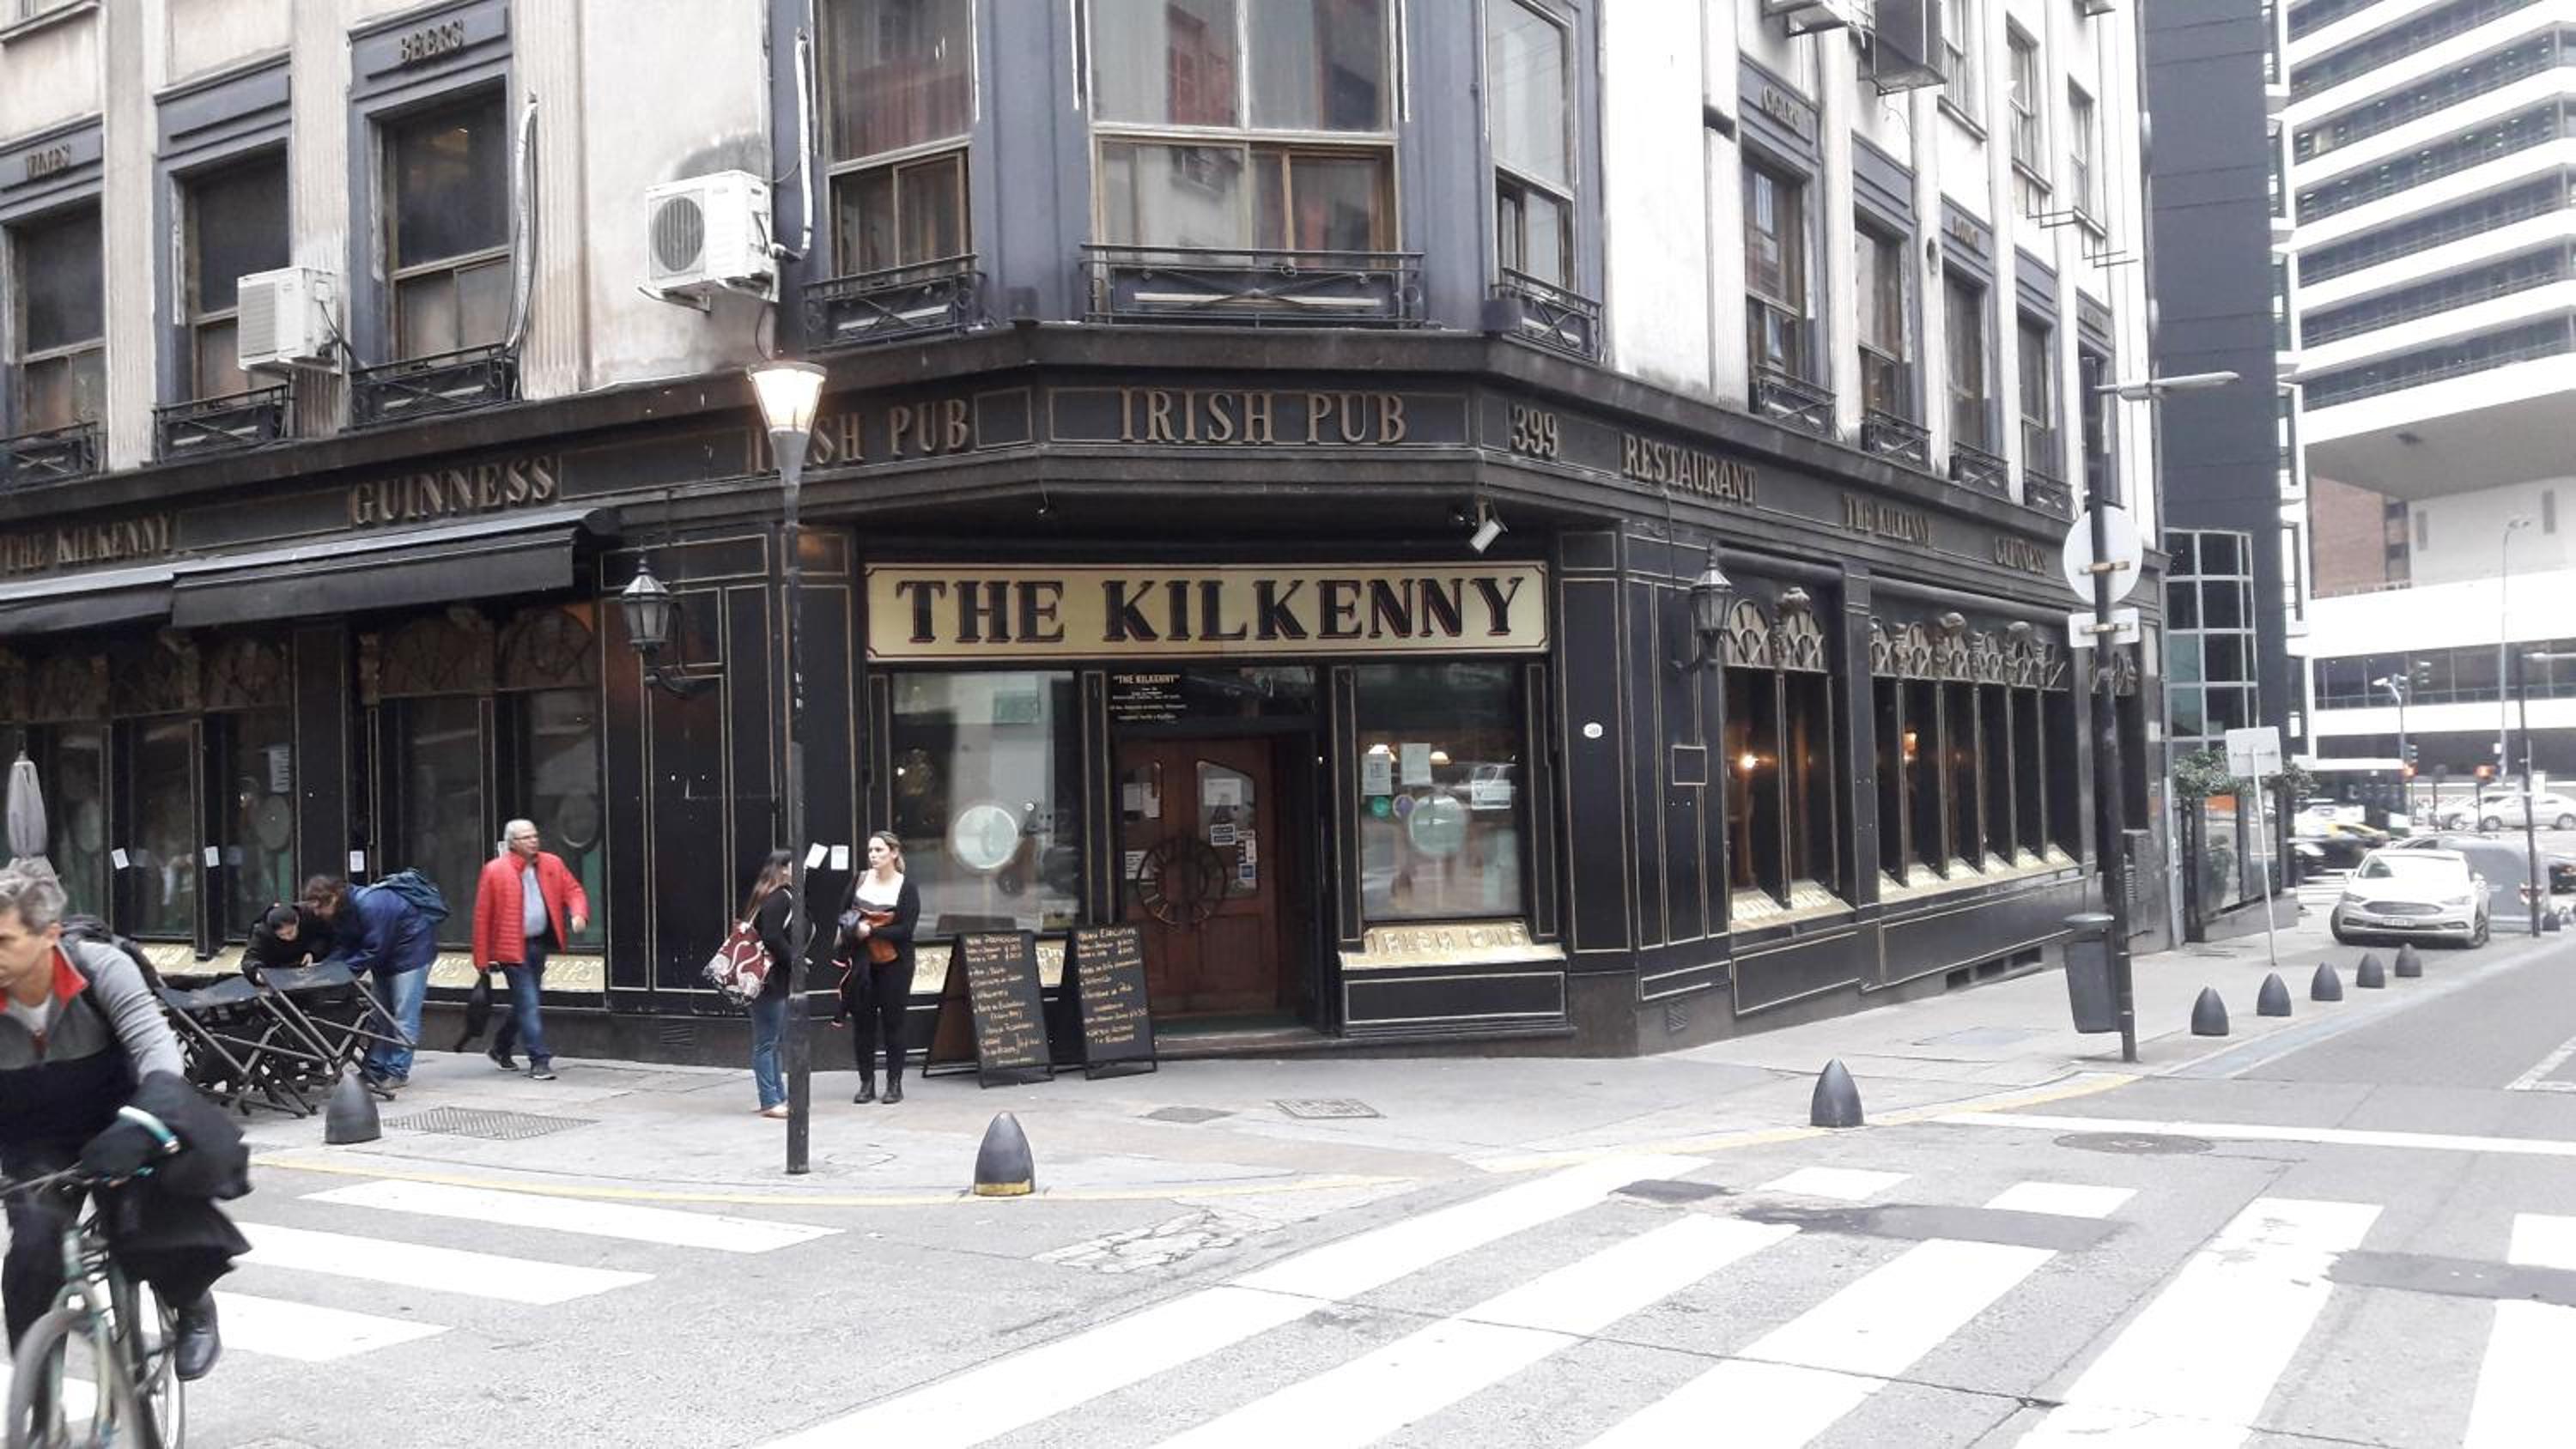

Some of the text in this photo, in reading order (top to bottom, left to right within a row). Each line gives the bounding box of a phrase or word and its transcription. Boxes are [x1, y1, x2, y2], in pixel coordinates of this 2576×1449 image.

[399, 19, 465, 63] BEERS
[745, 398, 969, 474] ISH PUB
[1120, 387, 1407, 443] IRISH PUB
[1510, 403, 1560, 458] 399
[349, 455, 556, 525] GUINNESS
[1622, 433, 1759, 504] RESTAURANT
[1843, 494, 1874, 530] THE
[2, 513, 172, 572] THE KILKENNY
[896, 577, 1524, 644] THE KILKENNY
